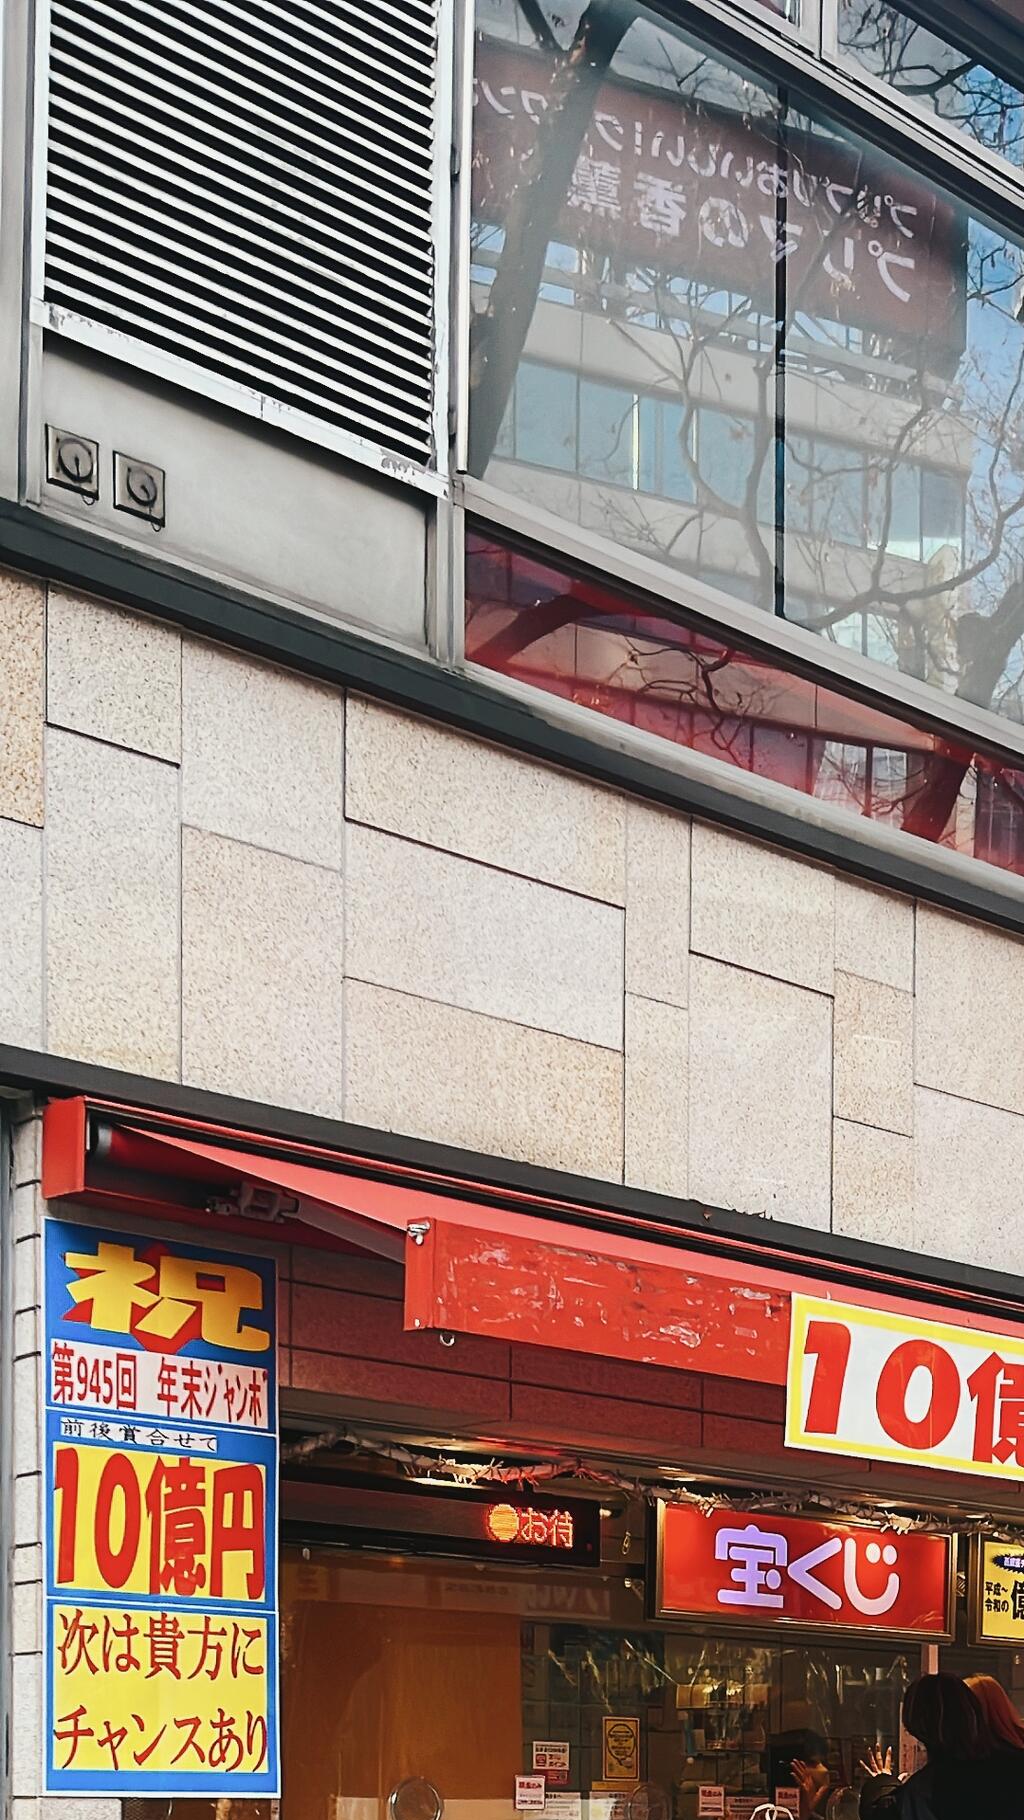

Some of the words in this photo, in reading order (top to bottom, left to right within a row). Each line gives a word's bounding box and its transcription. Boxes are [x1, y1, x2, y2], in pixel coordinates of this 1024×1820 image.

[64, 1241, 270, 1352] 祝
[52, 1342, 137, 1408] 第945回
[157, 1356, 268, 1424] 年末ジャンボ
[61, 1419, 217, 1452] 前後賞合せて
[55, 1448, 265, 1600] 10億円
[714, 1524, 900, 1616] 宝くじ
[58, 1611, 264, 1680] 次は貴方に
[53, 1704, 267, 1772] チャンスあり
